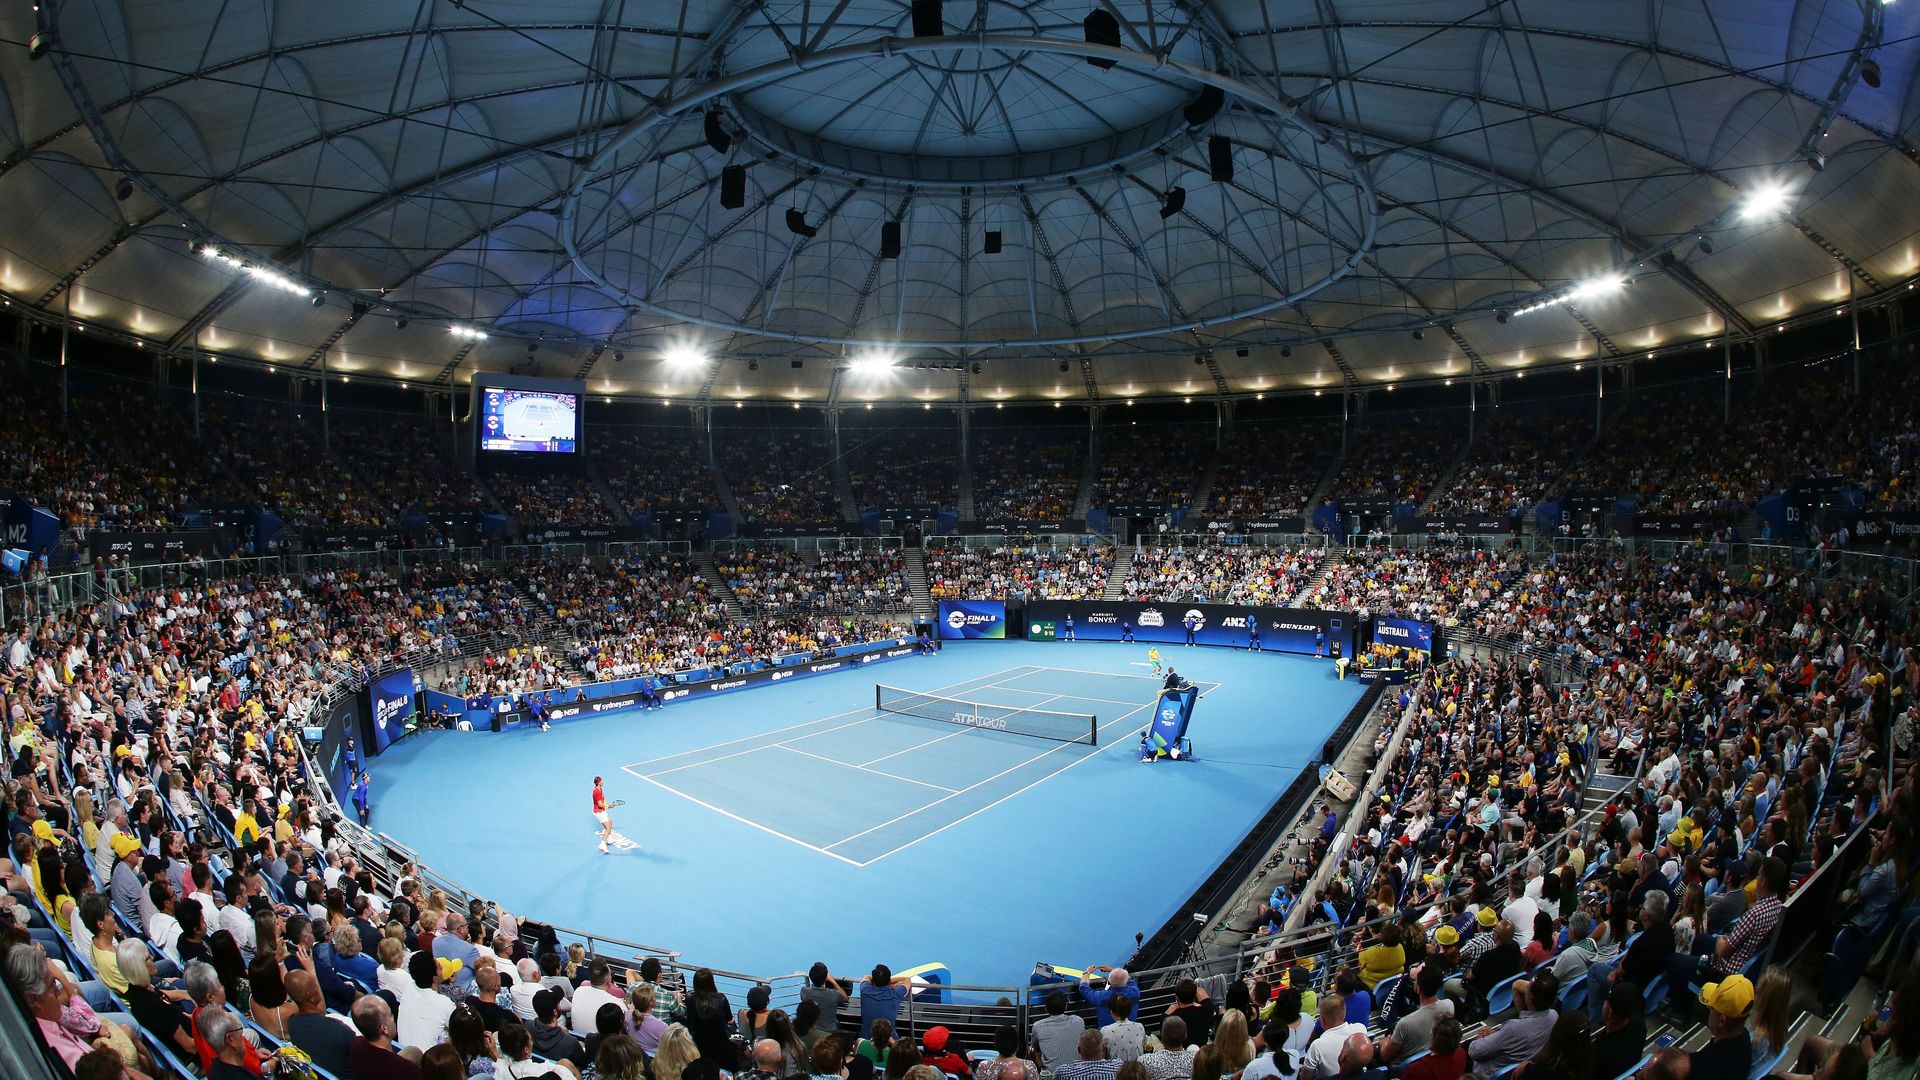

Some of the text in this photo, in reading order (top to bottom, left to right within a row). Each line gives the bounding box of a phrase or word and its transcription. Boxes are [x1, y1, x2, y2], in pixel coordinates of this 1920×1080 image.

[1786, 506, 1800, 521] D3
[9, 523, 27, 543] M2
[967, 614, 990, 622] FINAL
[1088, 616, 1118, 624] BONVOY
[1222, 616, 1246, 628] ANZ
[1280, 623, 1316, 631] DUNLOP
[1377, 626, 1409, 638] AUSTRALIA
[718, 680, 747, 690] sydney.com
[675, 688, 690, 698] NSW
[387, 694, 408, 713] FINAL 8
[601, 699, 635, 711] sydney.com
[563, 707, 580, 717] NSW
[952, 712, 976, 724] ATP
